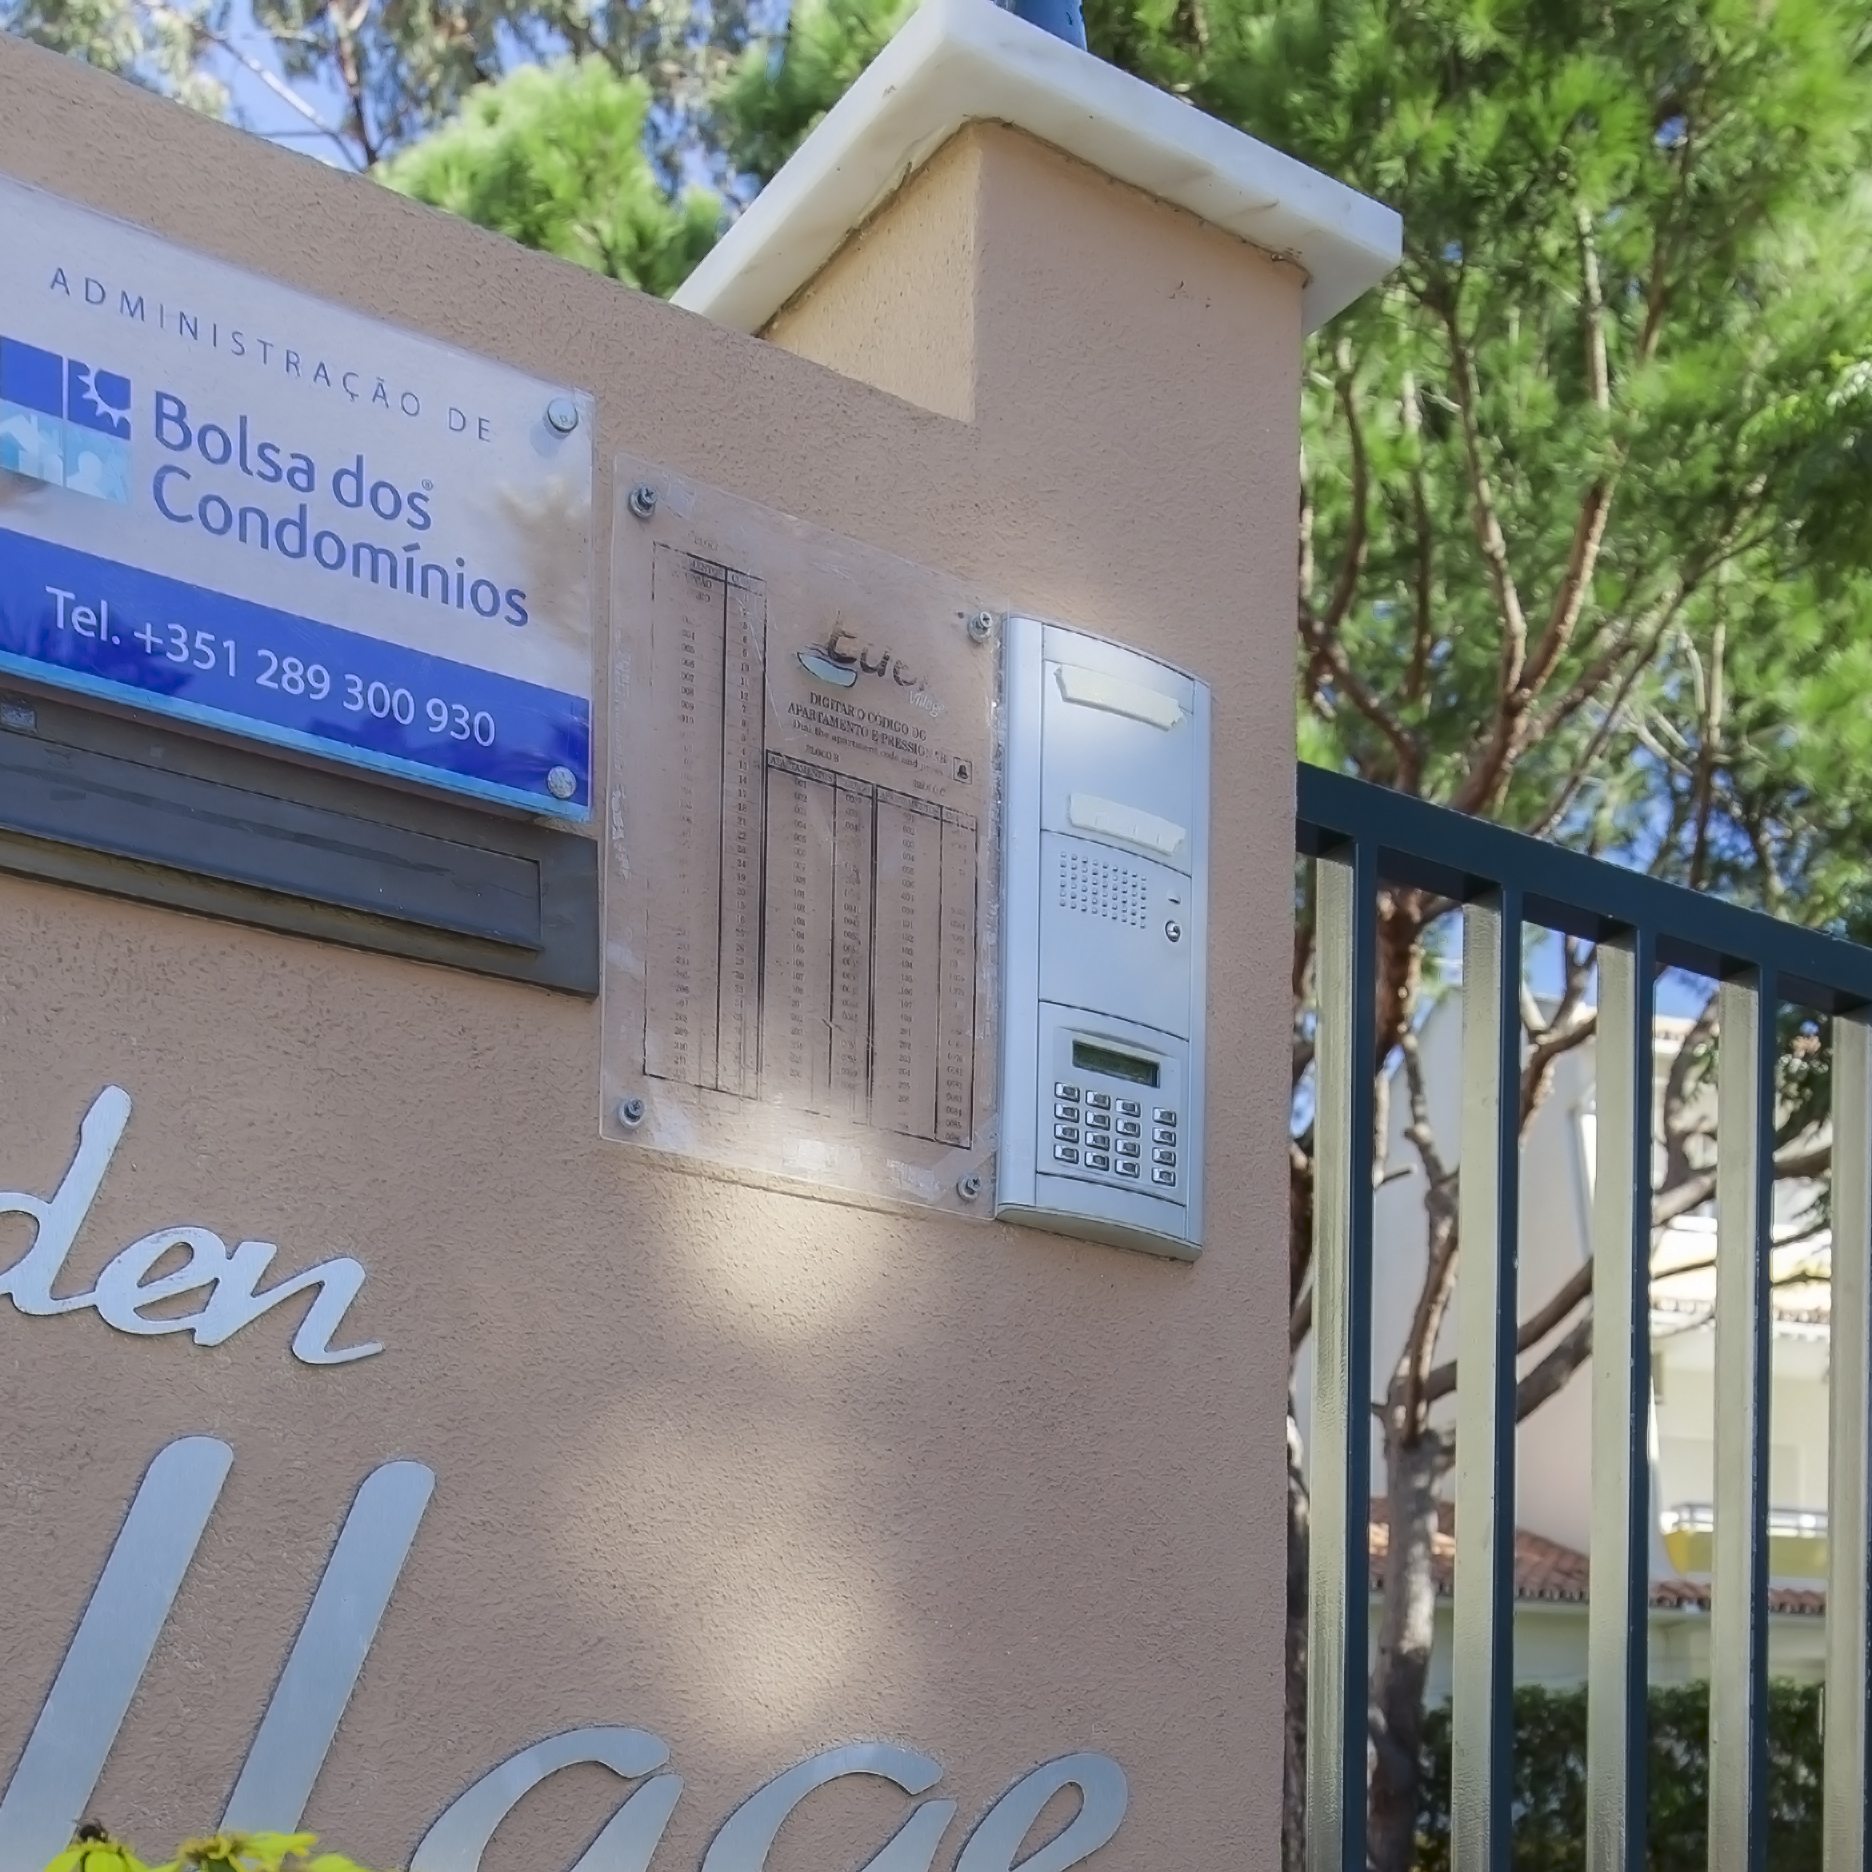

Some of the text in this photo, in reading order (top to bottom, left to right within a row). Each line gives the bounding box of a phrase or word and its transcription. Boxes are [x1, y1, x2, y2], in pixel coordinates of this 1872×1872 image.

[50, 267, 493, 444] ADMINISTRAÇÃO DE
[154, 390, 316, 493] Bolsa
[152, 463, 530, 627] Condomínios
[45, 585, 497, 748] Tel. +351 289 300 930
